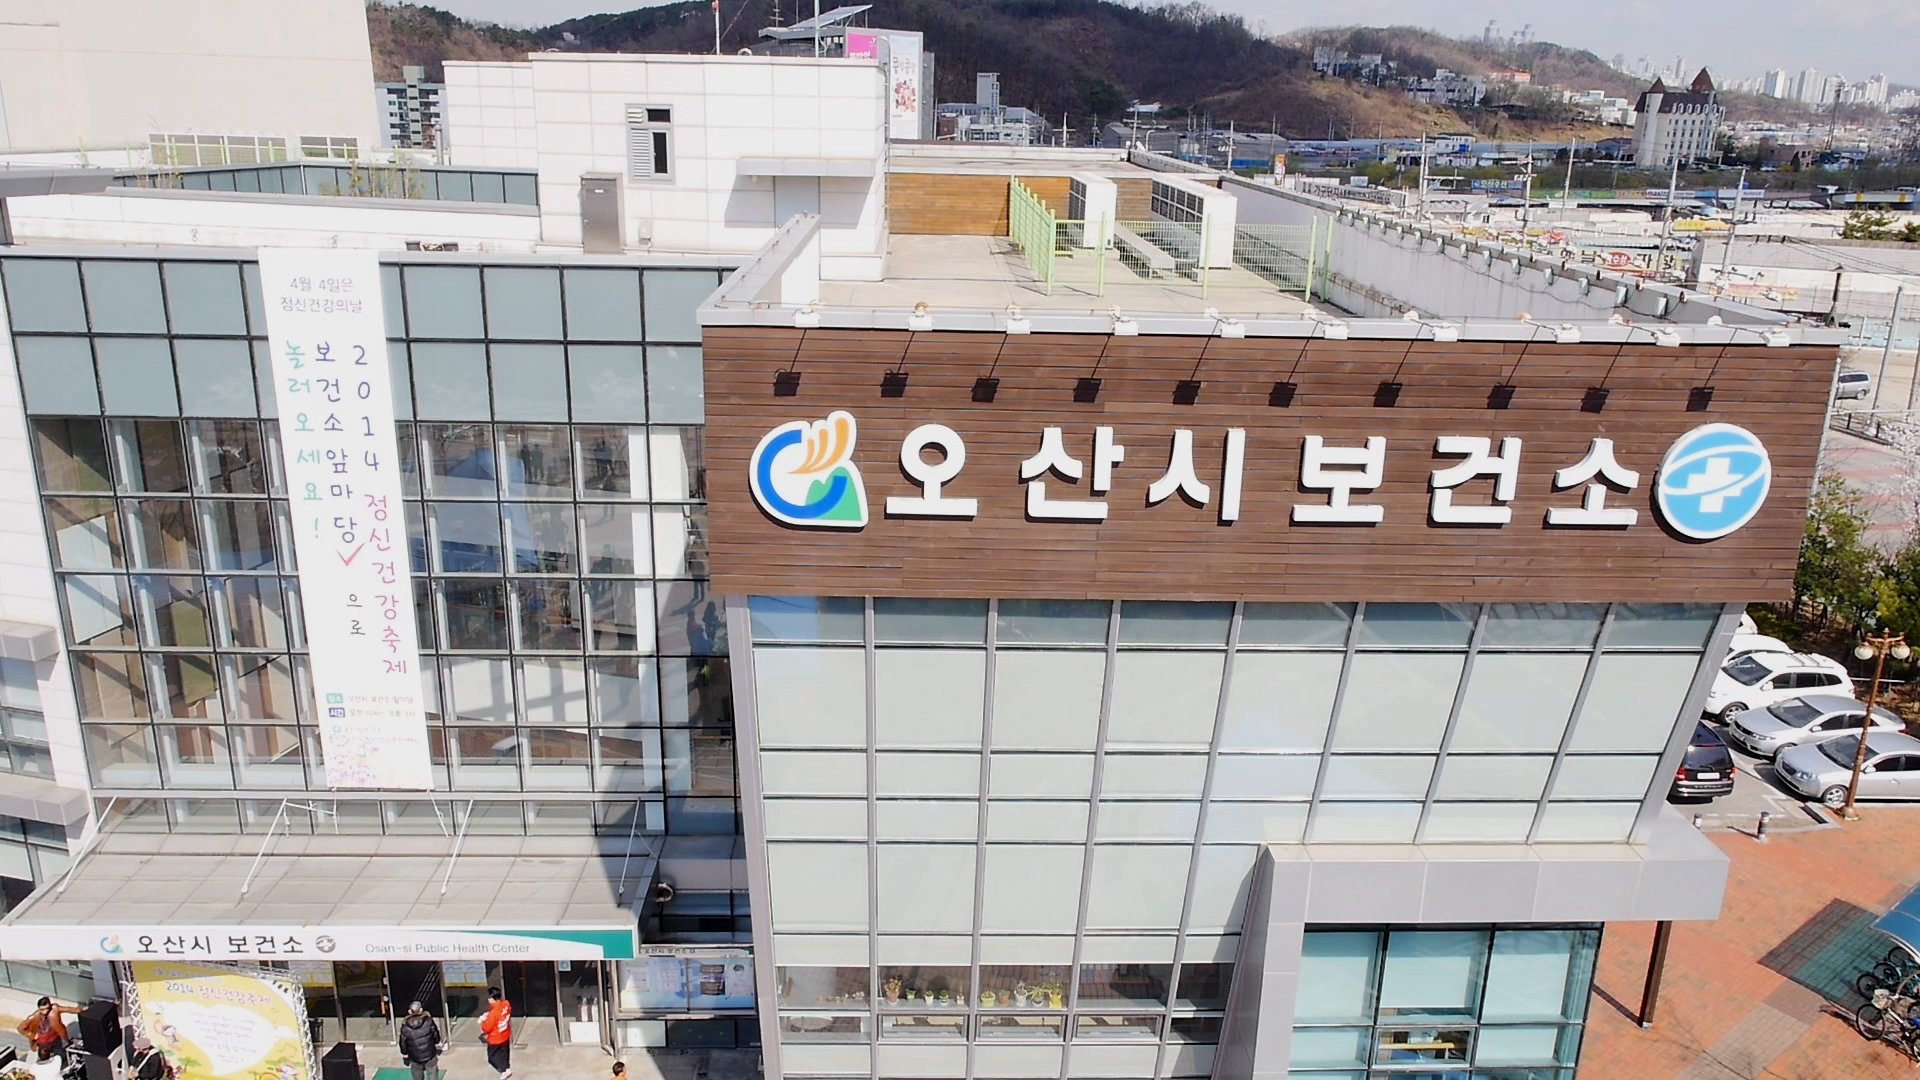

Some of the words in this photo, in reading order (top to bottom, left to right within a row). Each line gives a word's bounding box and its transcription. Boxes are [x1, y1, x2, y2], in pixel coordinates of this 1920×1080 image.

[290, 277, 312, 291] 4월
[318, 278, 355, 293] 4일은
[352, 345, 380, 472] 2014
[345, 594, 366, 636] 으로
[137, 934, 212, 955] 오산시
[228, 935, 304, 955] 보건소
[415, 943, 450, 955] Public
[453, 943, 490, 955] Health
[492, 943, 530, 955] Center
[166, 981, 195, 994] 2014
